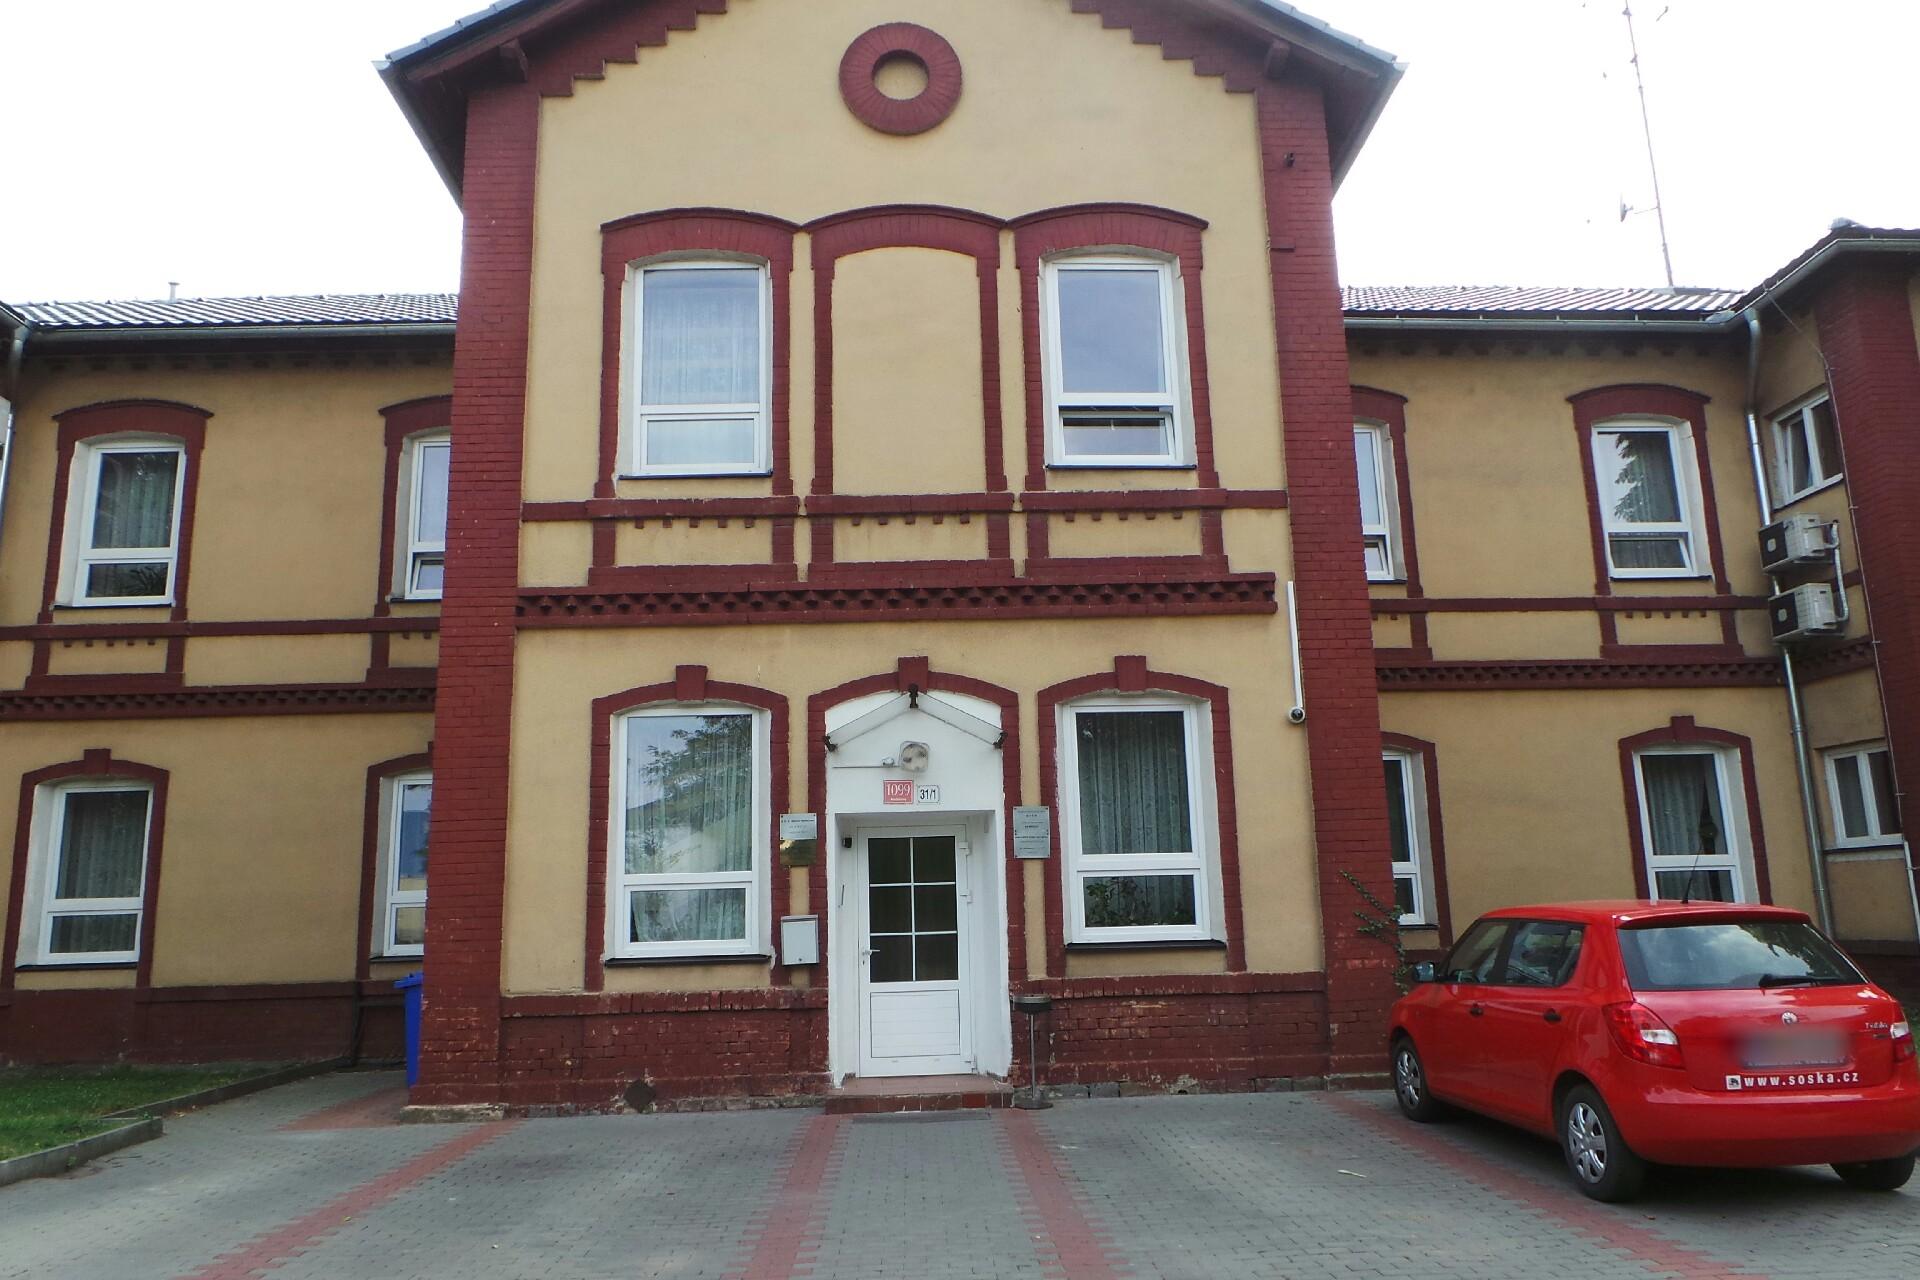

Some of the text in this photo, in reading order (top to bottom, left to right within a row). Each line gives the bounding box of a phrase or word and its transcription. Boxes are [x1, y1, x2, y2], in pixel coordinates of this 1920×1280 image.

[887, 783, 910, 795] 1099
[920, 788, 936, 800] 31/1
[1743, 1072, 1859, 1087] www.soska.cz
